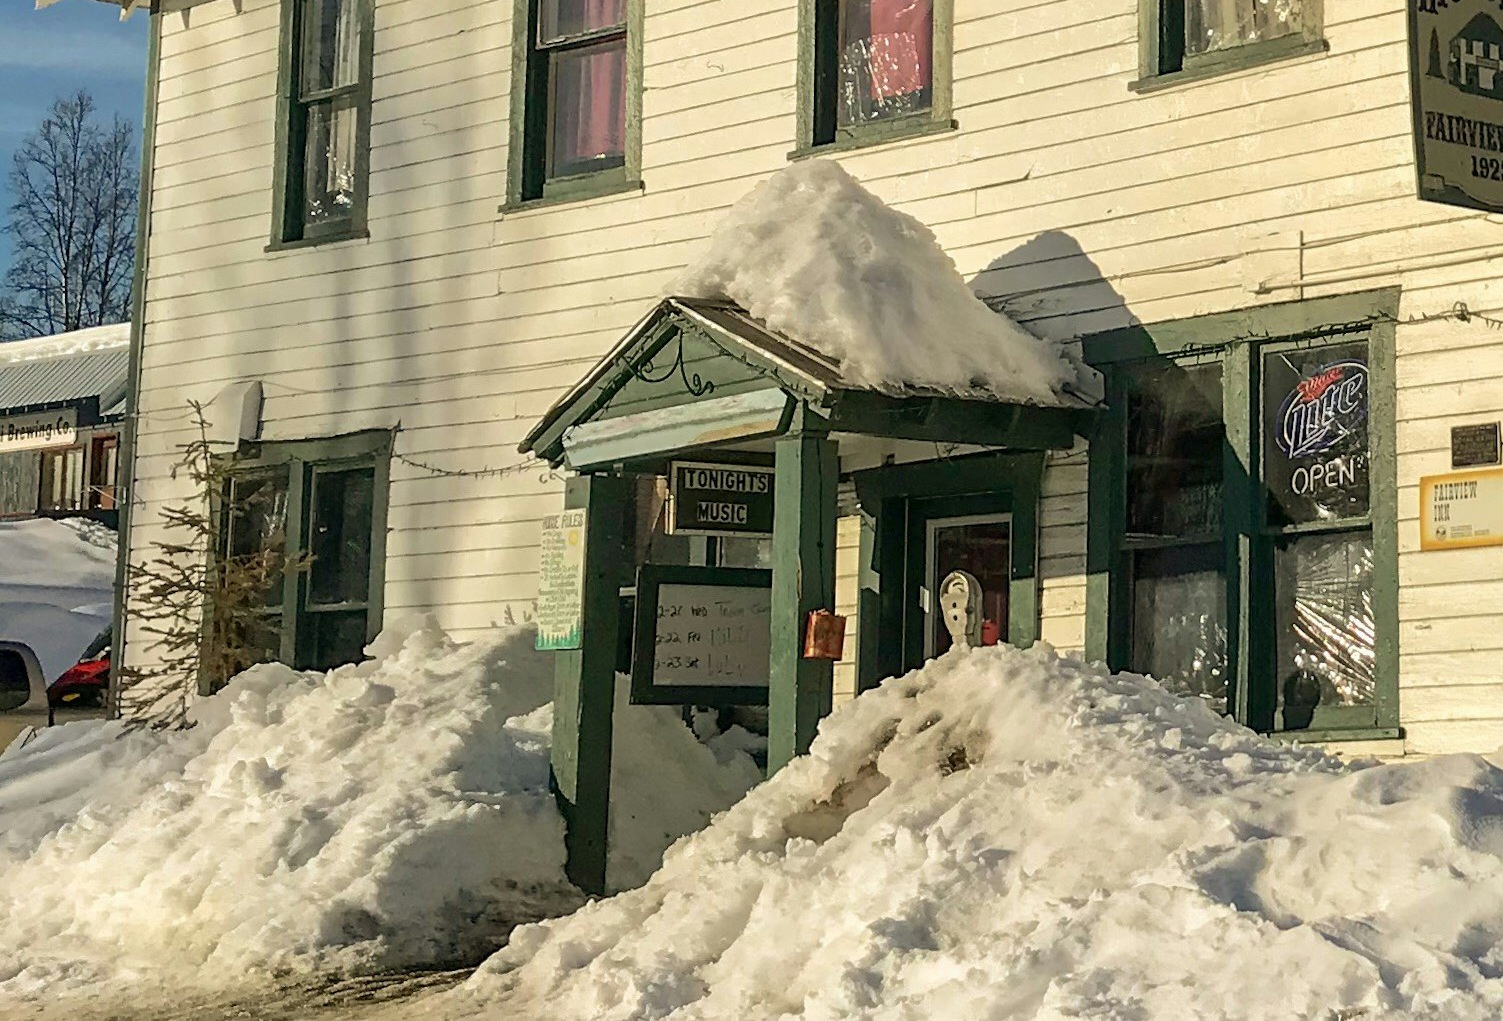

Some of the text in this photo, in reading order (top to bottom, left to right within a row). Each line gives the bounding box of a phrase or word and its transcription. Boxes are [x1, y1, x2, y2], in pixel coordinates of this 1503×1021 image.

[8, 419, 52, 441] Brewing
[1292, 458, 1354, 494] OPEN
[1434, 480, 1478, 502] FAIRVIEW
[699, 503, 746, 522] MUSIC
[1434, 503, 1450, 522] INN
